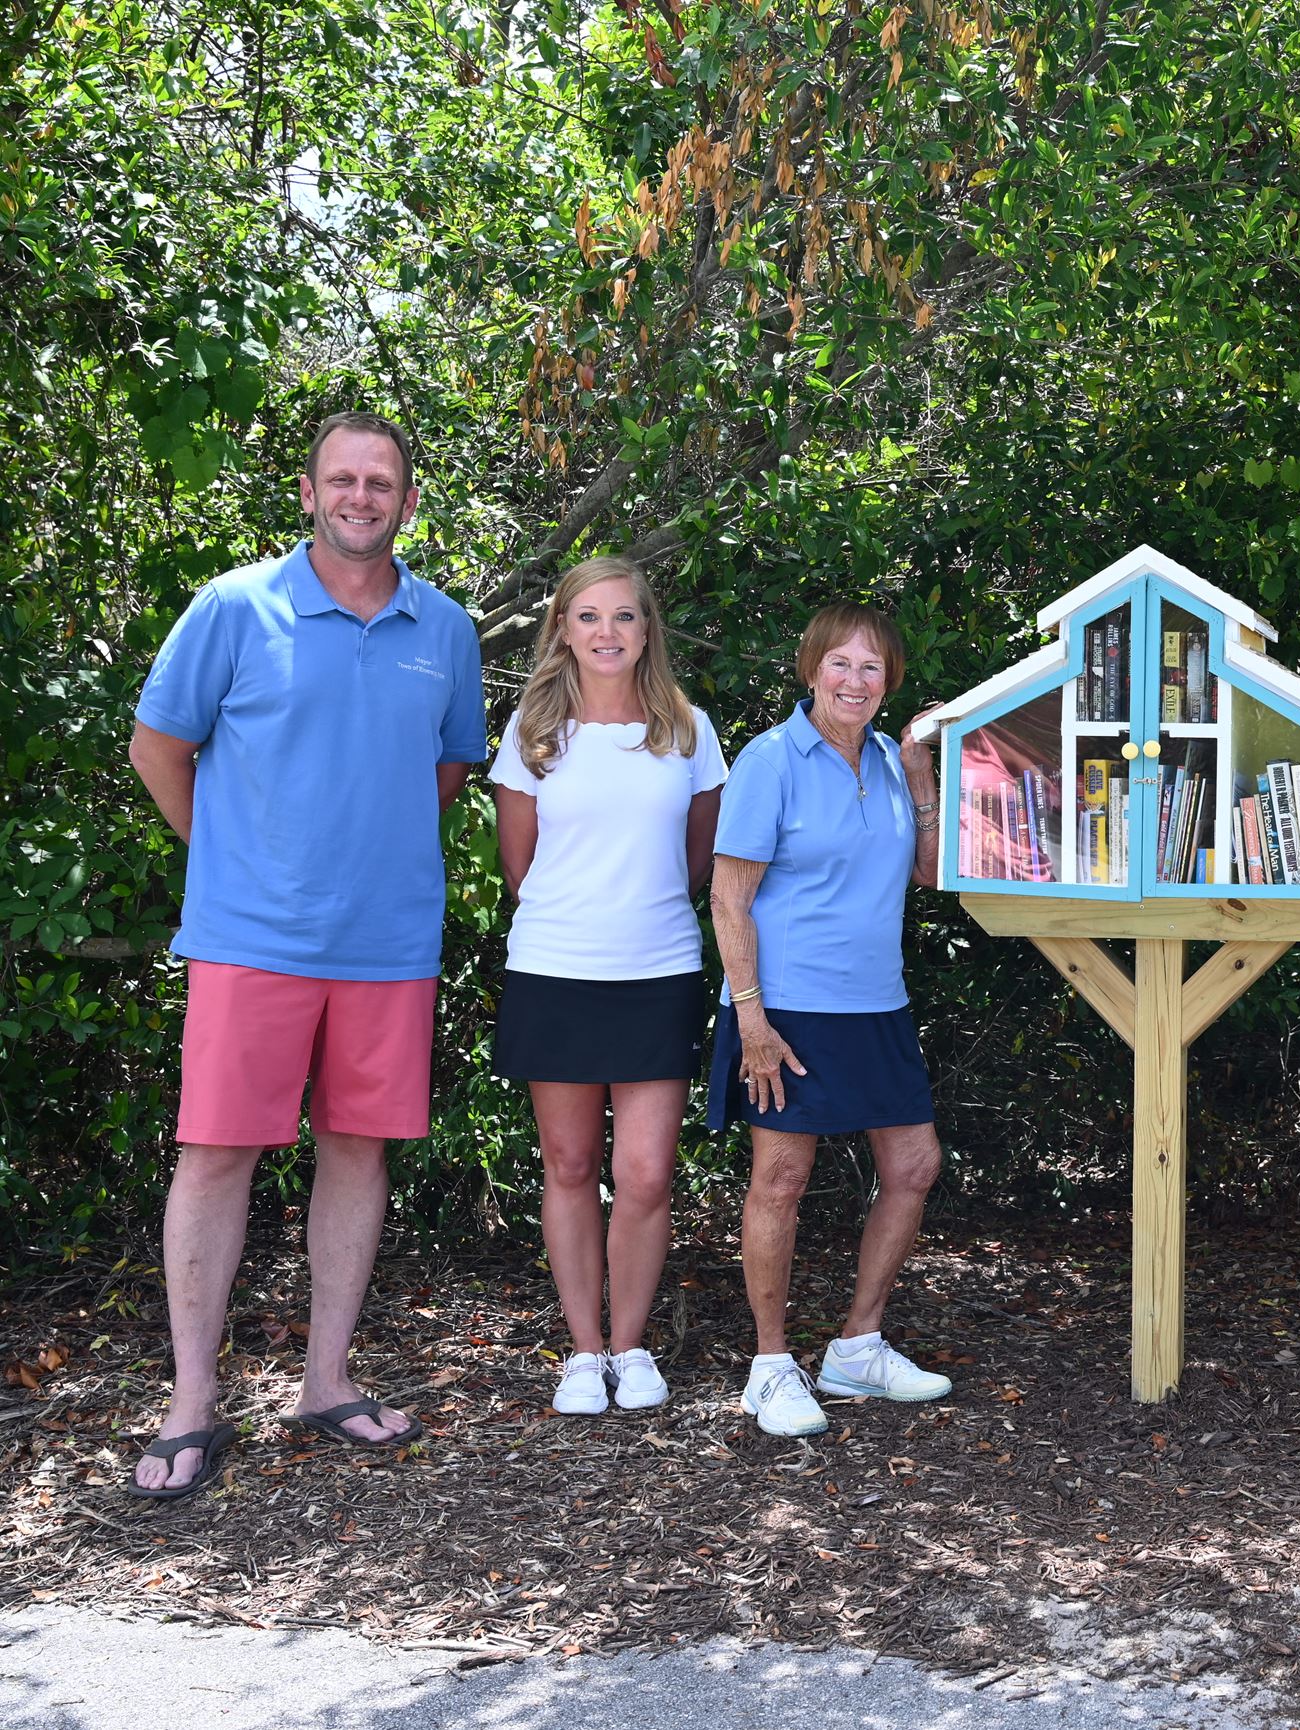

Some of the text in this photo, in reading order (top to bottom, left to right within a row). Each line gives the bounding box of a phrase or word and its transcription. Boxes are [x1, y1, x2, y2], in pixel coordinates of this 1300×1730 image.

[1165, 688, 1176, 714] EXILE
[1034, 774, 1042, 794] SPIDER
[1088, 765, 1096, 795] CUSSLER
[1095, 769, 1103, 790] CLIVE
[1273, 766, 1286, 788] ROBERT
[1260, 792, 1271, 809] The
[1276, 792, 1290, 814] PARKER
[1160, 819, 1168, 832] Gold
[1263, 809, 1275, 836] Heart
[1280, 817, 1292, 828] ALL
[1282, 827, 1293, 840] OUR
[1090, 819, 1098, 849] PLAGUE
[1268, 848, 1280, 872] Man
[1283, 839, 1298, 873] YESTERDAYS
